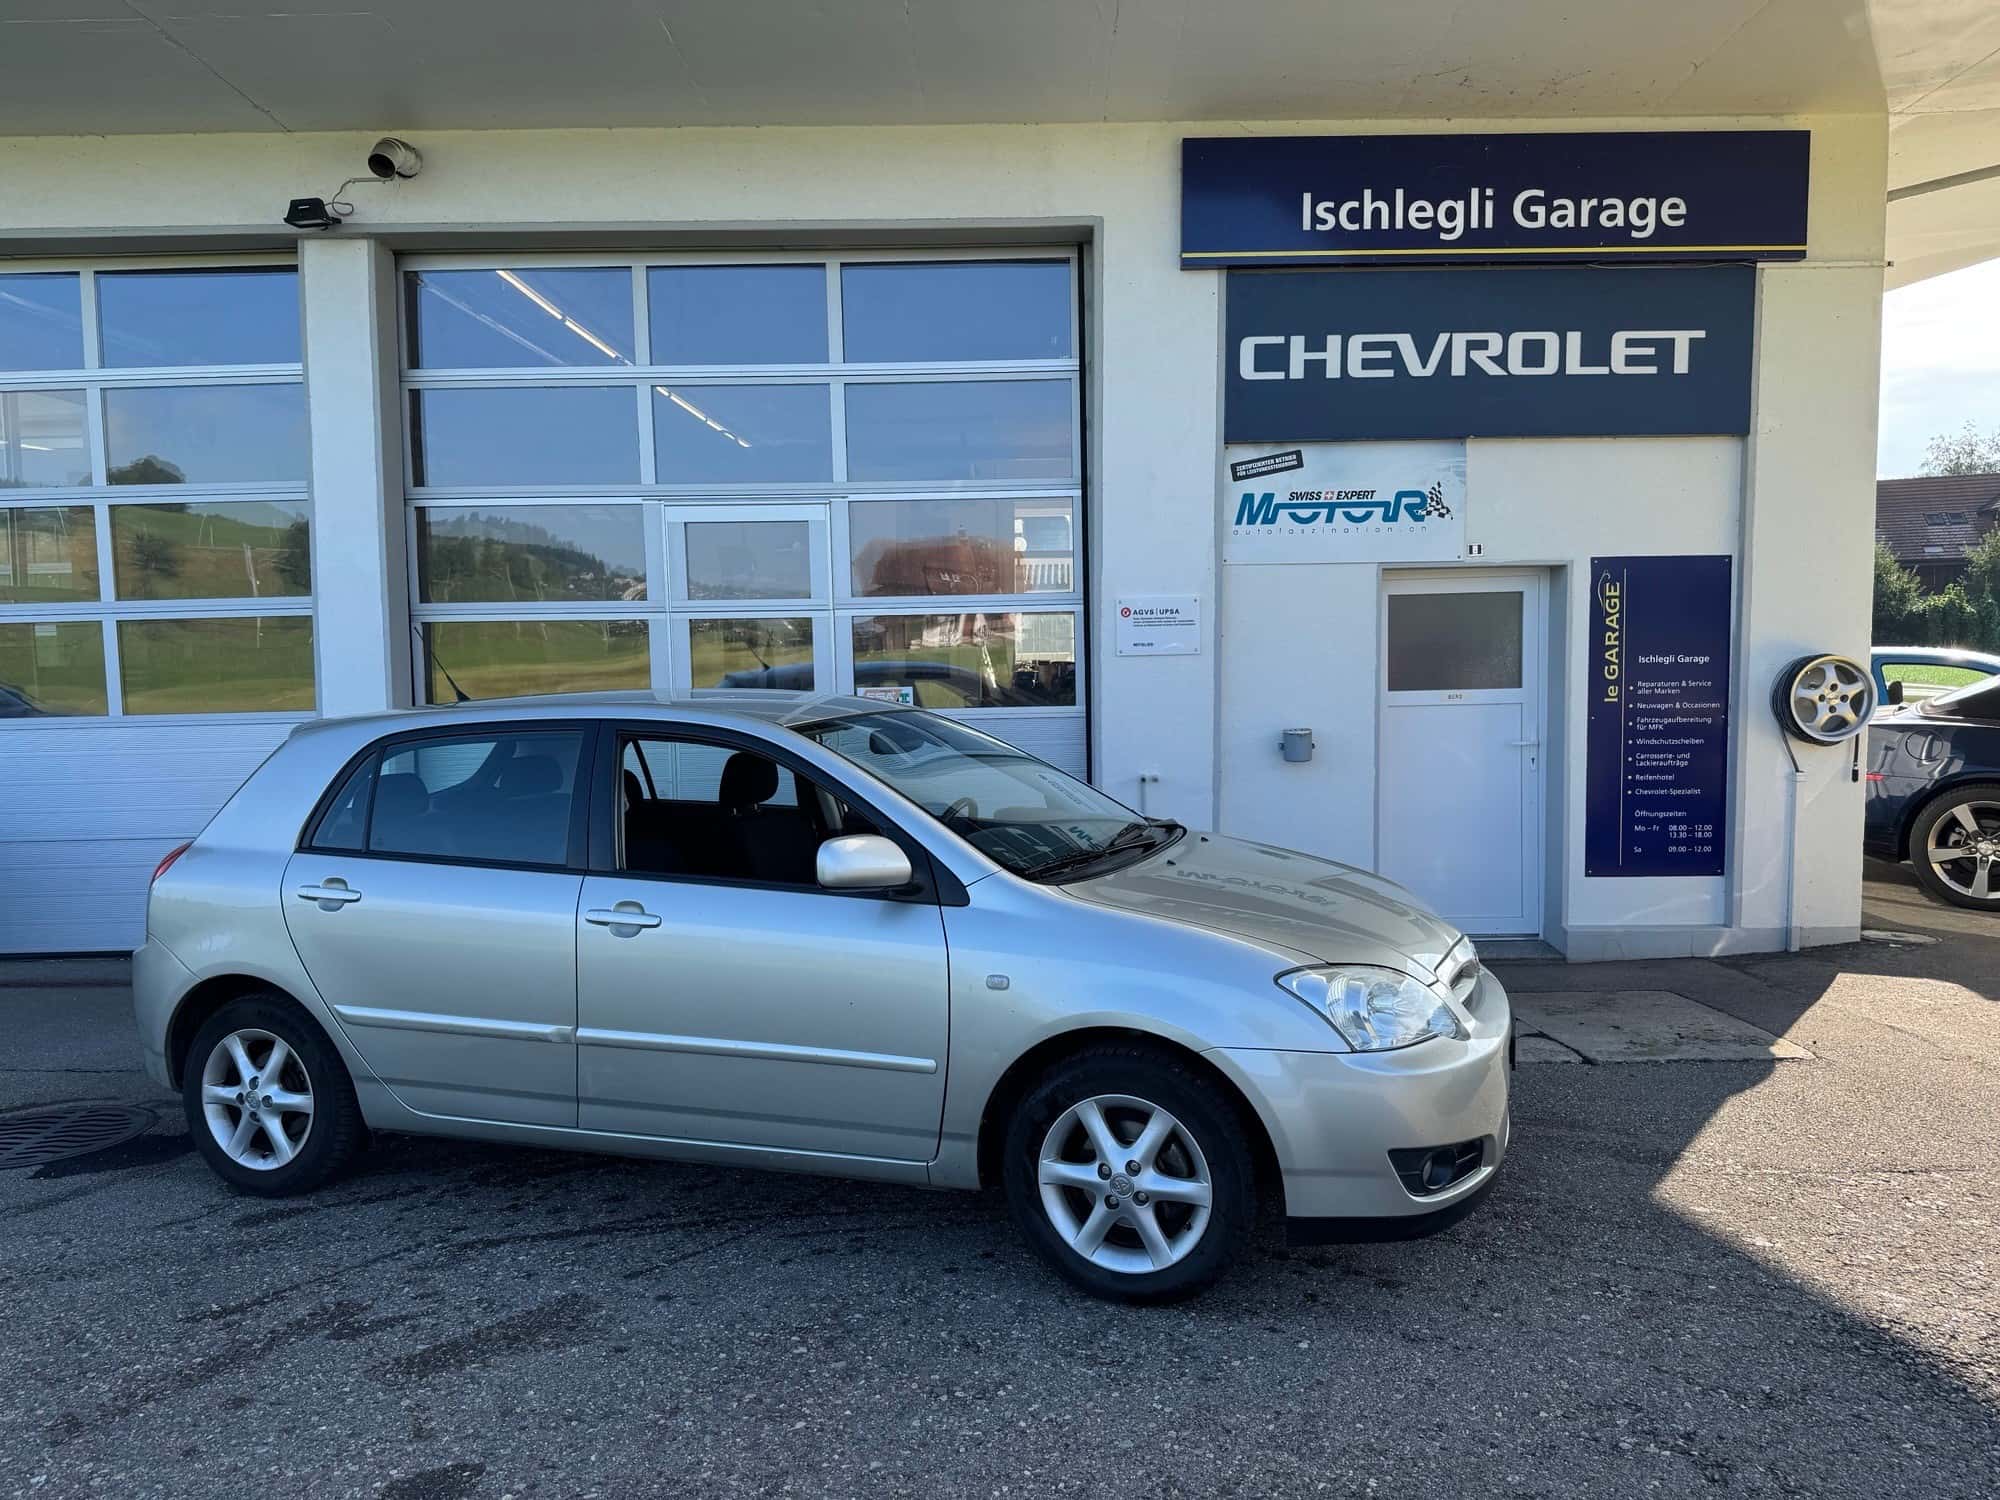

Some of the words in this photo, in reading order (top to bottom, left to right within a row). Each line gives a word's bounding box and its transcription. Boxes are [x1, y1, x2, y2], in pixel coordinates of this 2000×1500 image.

[1301, 187, 1495, 241] Ischlegli
[1511, 189, 1688, 240] Garage
[1238, 329, 1707, 381] CHEVROLET
[1288, 491, 1323, 501] SWISS
[1336, 490, 1376, 501] EXPERT
[1604, 582, 1620, 680] GARAGE
[1638, 654, 1675, 665] Ischlegli
[1677, 654, 1710, 665] Garage
[1637, 680, 1680, 688] Reparaturen
[1603, 685, 1619, 702] le
[1637, 702, 1674, 710] Neuwagen
[1636, 716, 1712, 725] Fahrzeugaufbereitung
[1635, 759, 1689, 768] Lackieraufträge
[1635, 773, 1675, 781] Reifenhotel
[1634, 788, 1702, 796] Chevrolet-Spezialist
[1634, 809, 1687, 819] Öffnungszeiten
[1652, 824, 1660, 832] Fr
